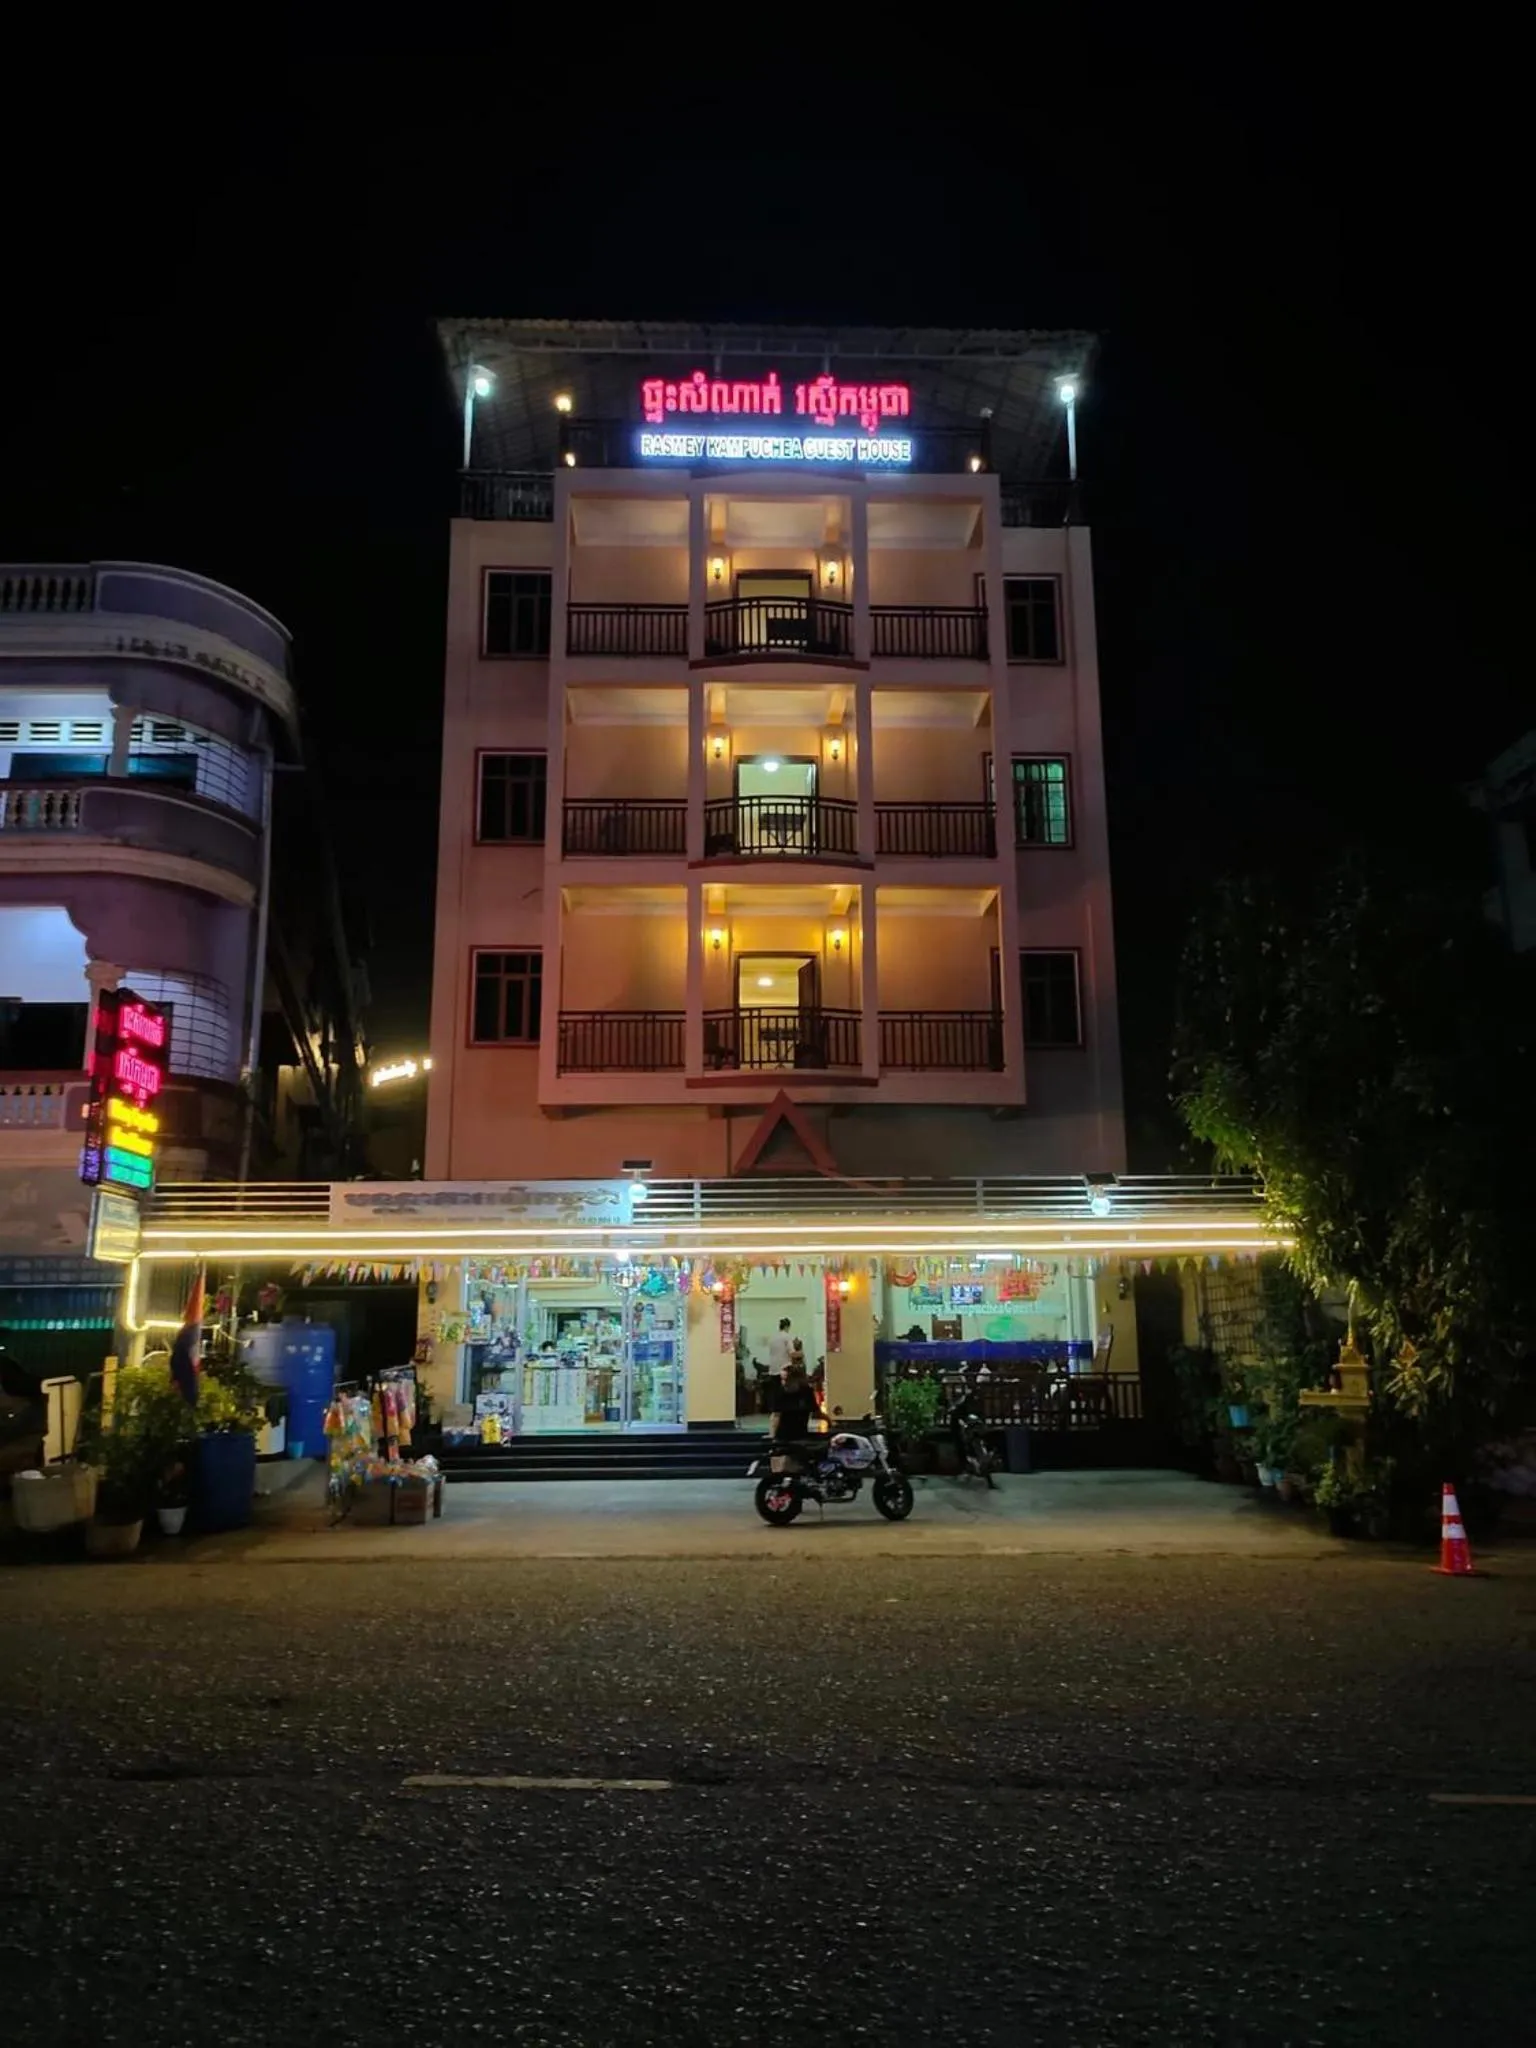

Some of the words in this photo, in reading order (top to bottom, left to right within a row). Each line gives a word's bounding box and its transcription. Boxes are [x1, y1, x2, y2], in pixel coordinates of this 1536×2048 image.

[641, 434, 705, 456] RASMEY
[706, 436, 803, 458] KAMPUCHEA
[803, 438, 855, 460] GUEST
[857, 439, 912, 461] HOUSE
